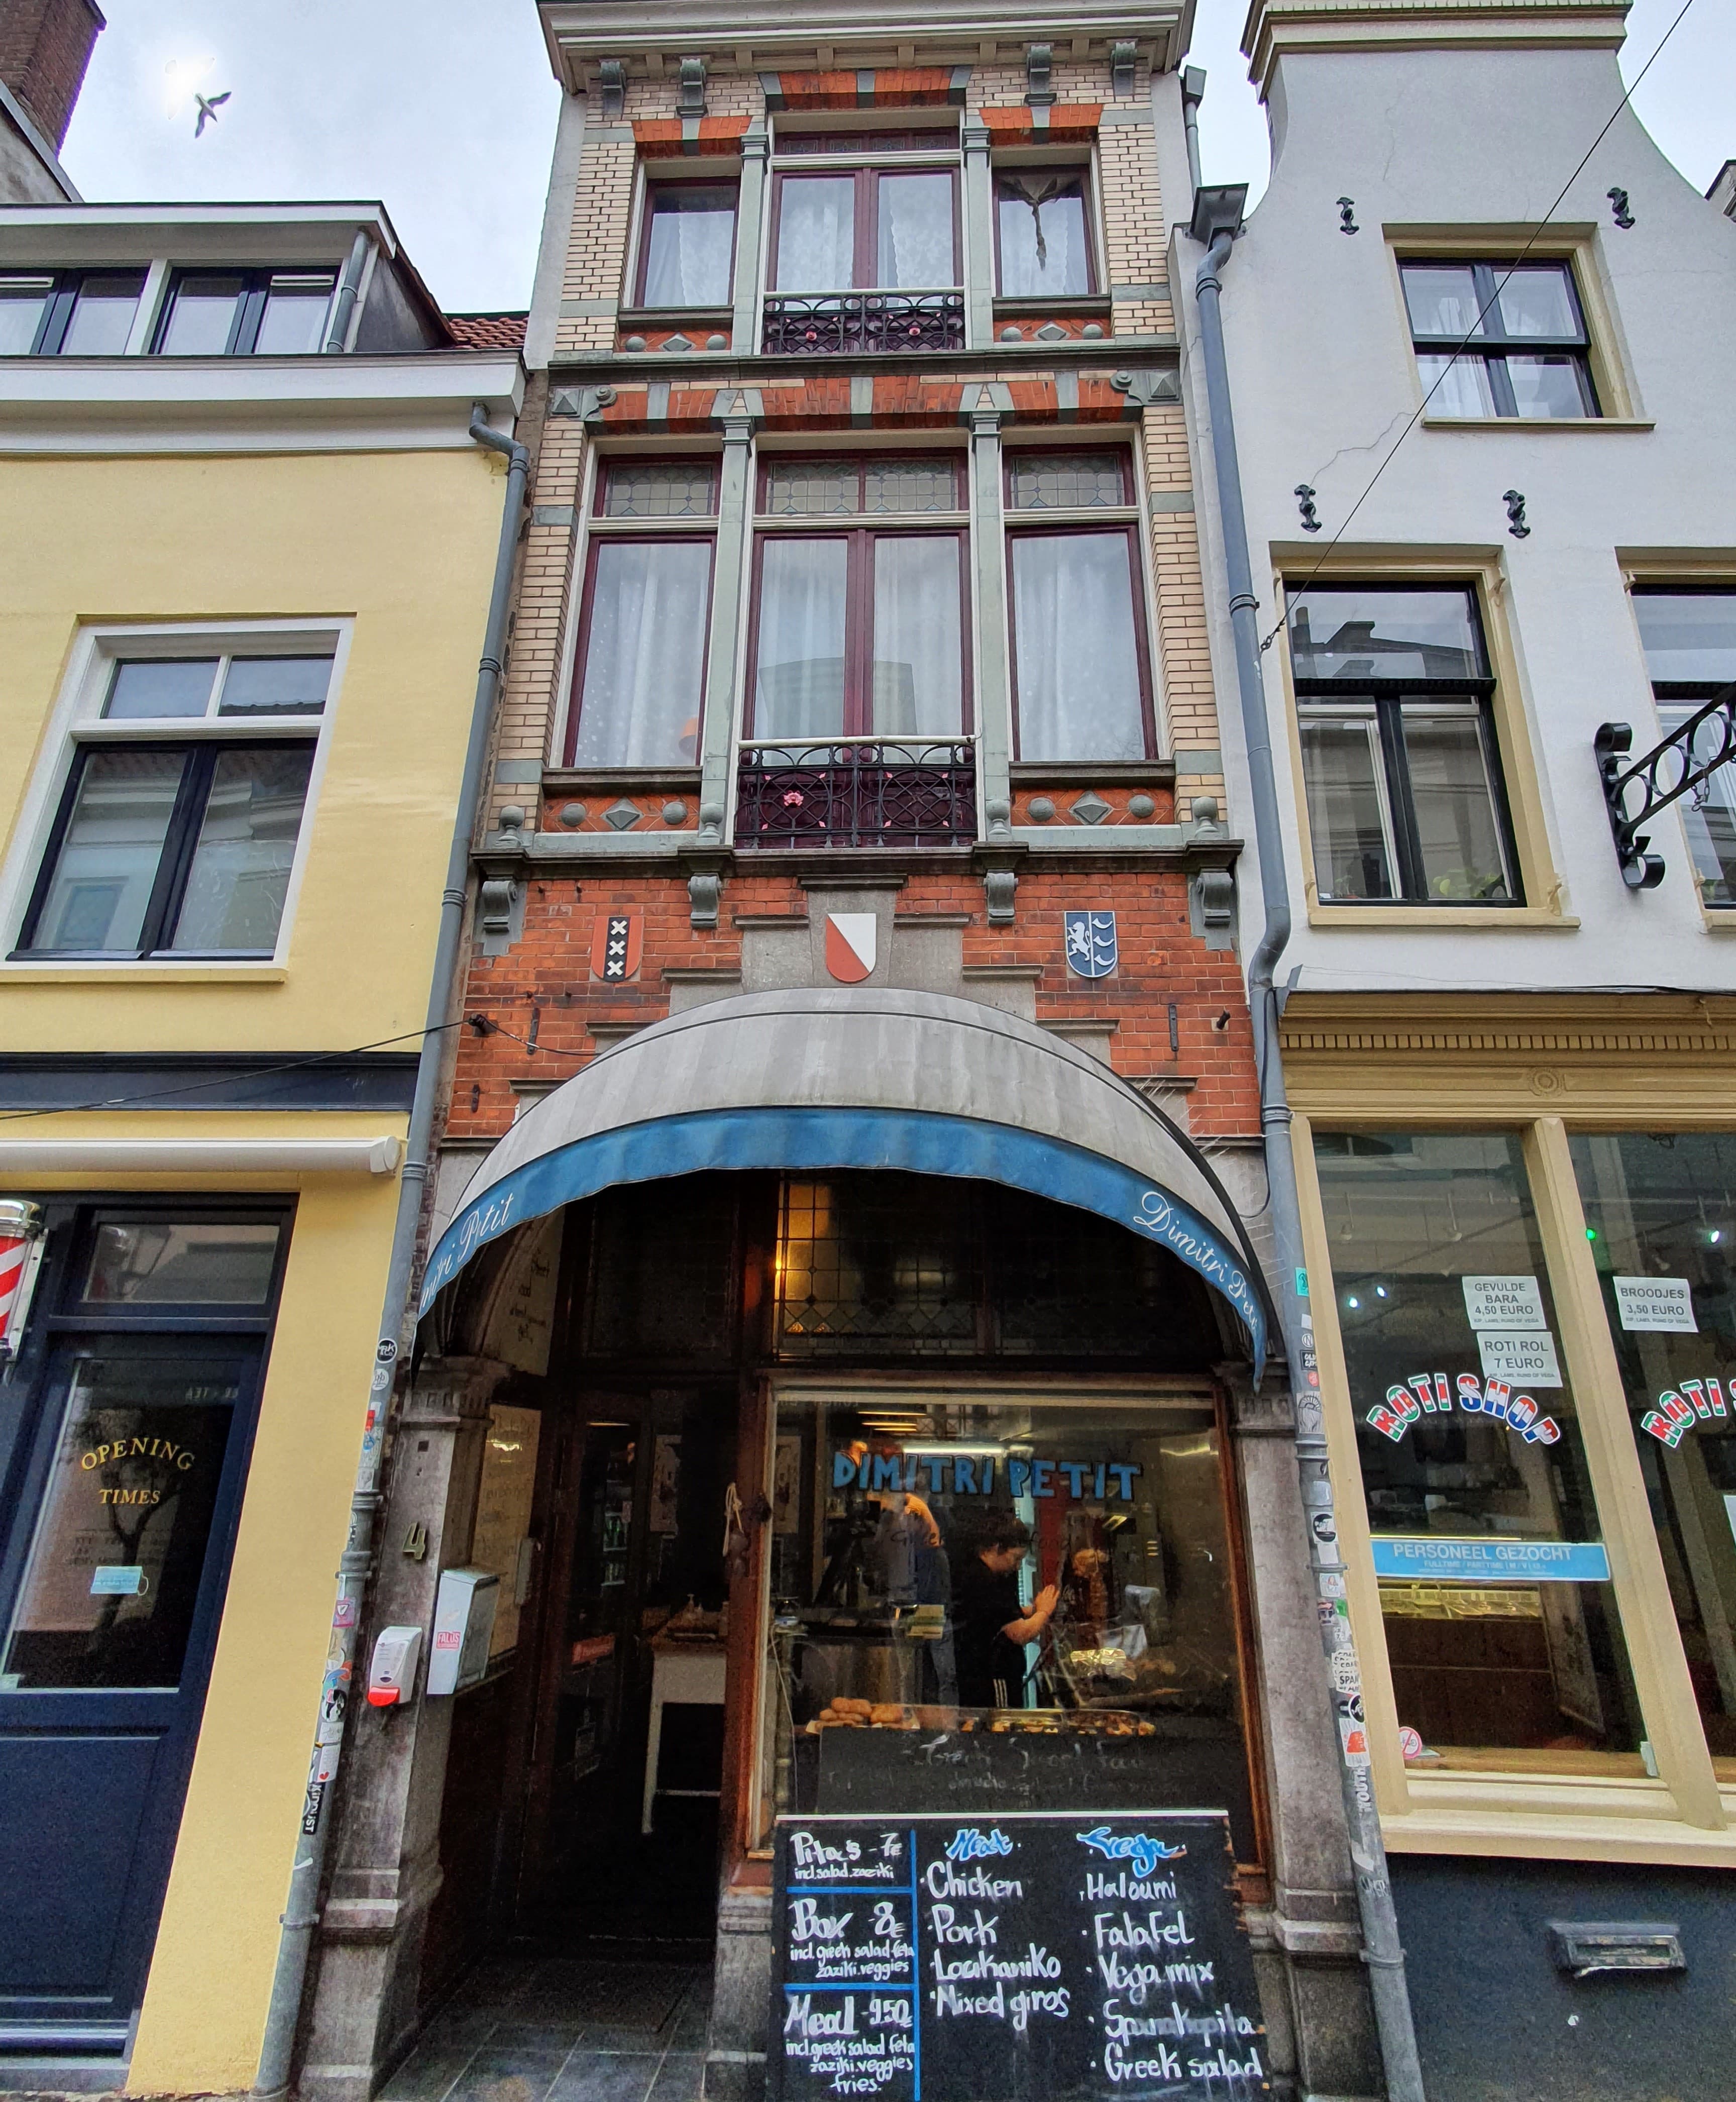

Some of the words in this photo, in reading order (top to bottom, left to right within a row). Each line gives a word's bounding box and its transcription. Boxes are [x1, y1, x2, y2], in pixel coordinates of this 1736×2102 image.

[1133, 1191, 1228, 1282] Dimitri
[1475, 1283, 1526, 1292] GEVULDE
[1485, 1294, 1520, 1304] BARA
[1620, 1288, 1685, 1299] BROODJES
[1475, 1305, 1497, 1316] 4,50
[1500, 1305, 1534, 1315] EURO
[1627, 1304, 1649, 1314] 3,50
[1652, 1305, 1685, 1315] EURO
[1484, 1341, 1516, 1351] ROTI
[1520, 1341, 1549, 1352] ROL
[1494, 1357, 1501, 1369] 7
[1505, 1358, 1545, 1369] EURO
[1366, 1373, 1453, 1443] ROTI
[1457, 1373, 1561, 1445] SHOP
[1641, 1378, 1727, 1448] ROTI
[81, 1437, 195, 1471] OPENING
[832, 1451, 996, 1496] DIMITRI
[1008, 1457, 1143, 1501] PETIT
[99, 1489, 161, 1505] TIMES
[402, 1522, 425, 1560] 4
[1393, 1544, 1492, 1561] PERSONEEL
[1495, 1547, 1572, 1560] GEZOCHT
[790, 1832, 861, 1865] Pita's
[945, 1828, 1013, 1861] Meat
[926, 1861, 1023, 1899] Chicken
[1087, 1871, 1176, 1901] Haloumi
[788, 1898, 854, 1941] Box
[931, 1904, 999, 1946] Pork
[816, 1942, 851, 1967] greek
[854, 1939, 890, 1958] salad
[1098, 1951, 1161, 2005] Vega
[1165, 1955, 1215, 1982] mix
[937, 1981, 1004, 2019] Mixed
[1010, 1986, 1070, 2031] giros
[848, 2033, 885, 2056] salad
[1105, 2041, 1182, 2081] Greek
[1187, 2047, 1263, 2078] salad
